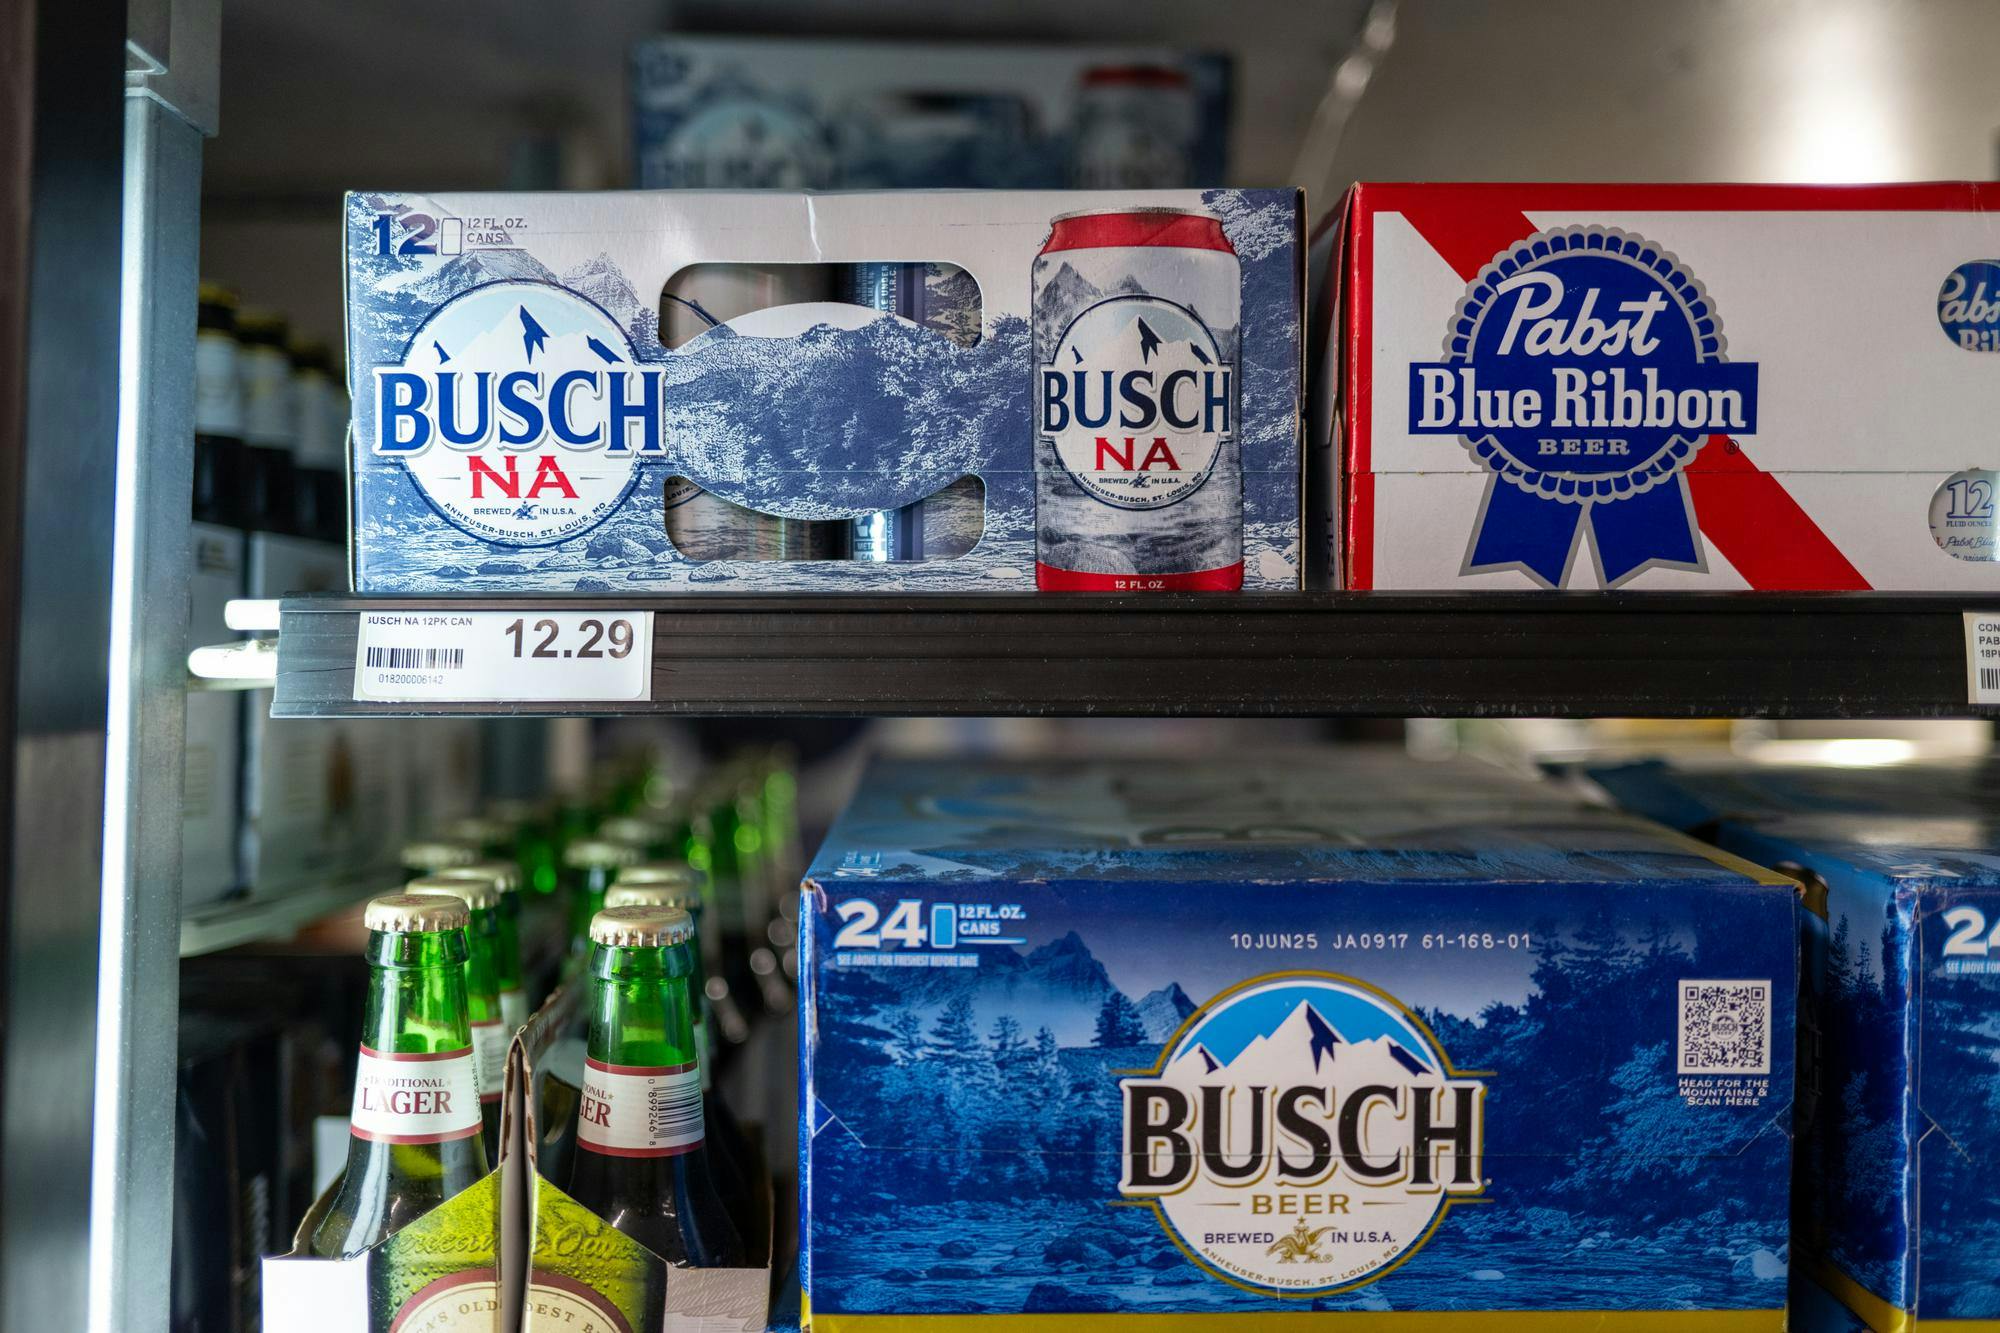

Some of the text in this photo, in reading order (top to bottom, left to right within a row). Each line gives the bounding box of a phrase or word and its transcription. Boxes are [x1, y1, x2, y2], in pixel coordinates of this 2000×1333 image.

[372, 213, 438, 256] 12
[466, 232, 504, 243] CANS
[880, 264, 889, 296] UNDER
[1496, 270, 1668, 356] Pabst
[376, 368, 667, 453] BUSCH
[1043, 369, 1232, 434] BUSCH
[1417, 366, 1746, 428] Blue Ribbon
[1094, 437, 1182, 471] NA
[1537, 438, 1631, 456] BEER
[467, 455, 580, 499] NA
[473, 507, 577, 515] BREWED IN U.S.A.
[1946, 479, 1994, 518] 12
[540, 529, 556, 538] ST.
[558, 514, 592, 533] LOUIS,
[592, 502, 607, 515] MO
[1114, 580, 1127, 589] 12
[1130, 580, 1147, 589] FL.
[404, 617, 419, 626] NA
[423, 617, 448, 626] 12PK
[450, 617, 473, 626] CAN
[505, 618, 634, 659] 12.29
[833, 898, 928, 949] 24
[958, 920, 1001, 936] CANS
[1230, 933, 1531, 949] 10JUN25 JA0917 61-168-01
[370, 1076, 445, 1088] TRDITIONAL
[1757, 1088, 1768, 1097] &
[362, 1087, 453, 1115] LAGER
[648, 1091, 658, 1133] 899246
[1127, 1083, 1478, 1187] BUSCH
[1251, 1193, 1351, 1216] BEER
[1204, 1231, 1397, 1244] BREWED IN U.S.A.
[1201, 1245, 1400, 1287] ANHEUSER-BUSCH, ST. LOUIS, MO
